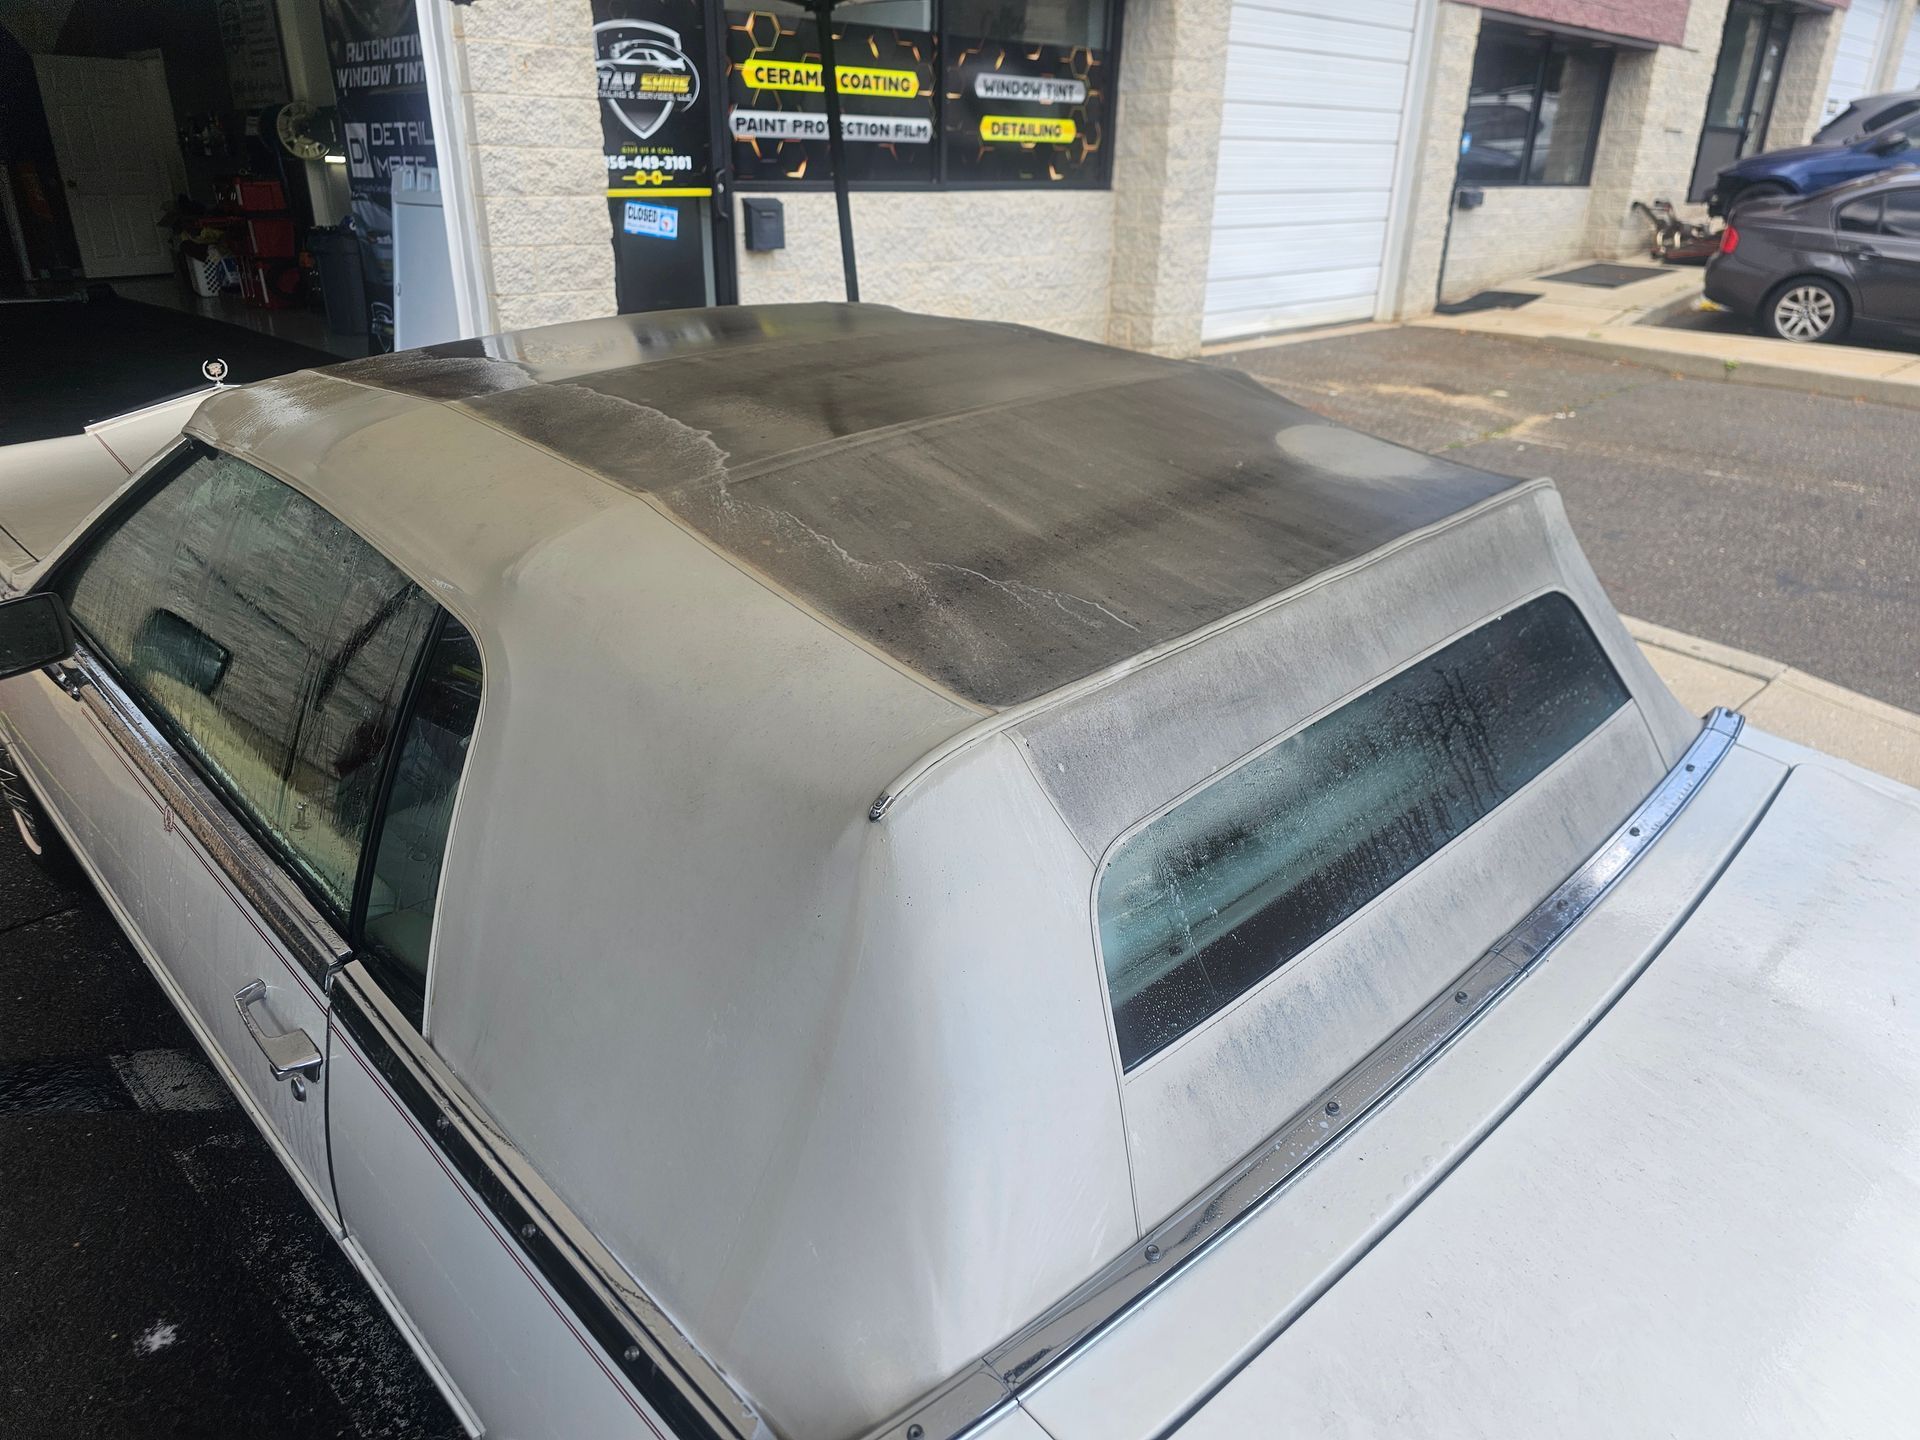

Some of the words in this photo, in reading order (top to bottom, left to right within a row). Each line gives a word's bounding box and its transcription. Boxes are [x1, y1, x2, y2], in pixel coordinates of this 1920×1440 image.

[337, 64, 391, 88] WINDOW
[597, 71, 636, 91] TAY
[640, 73, 691, 93] SHINE
[840, 72, 911, 92] COATING
[983, 78, 1041, 96] WINDOW
[1043, 83, 1075, 97] TINT
[371, 121, 434, 146] DETAIL
[736, 117, 787, 133] PAINT
[894, 123, 928, 139] FILM
[991, 121, 1062, 138] DETAILING
[628, 206, 658, 223] CLOSED
